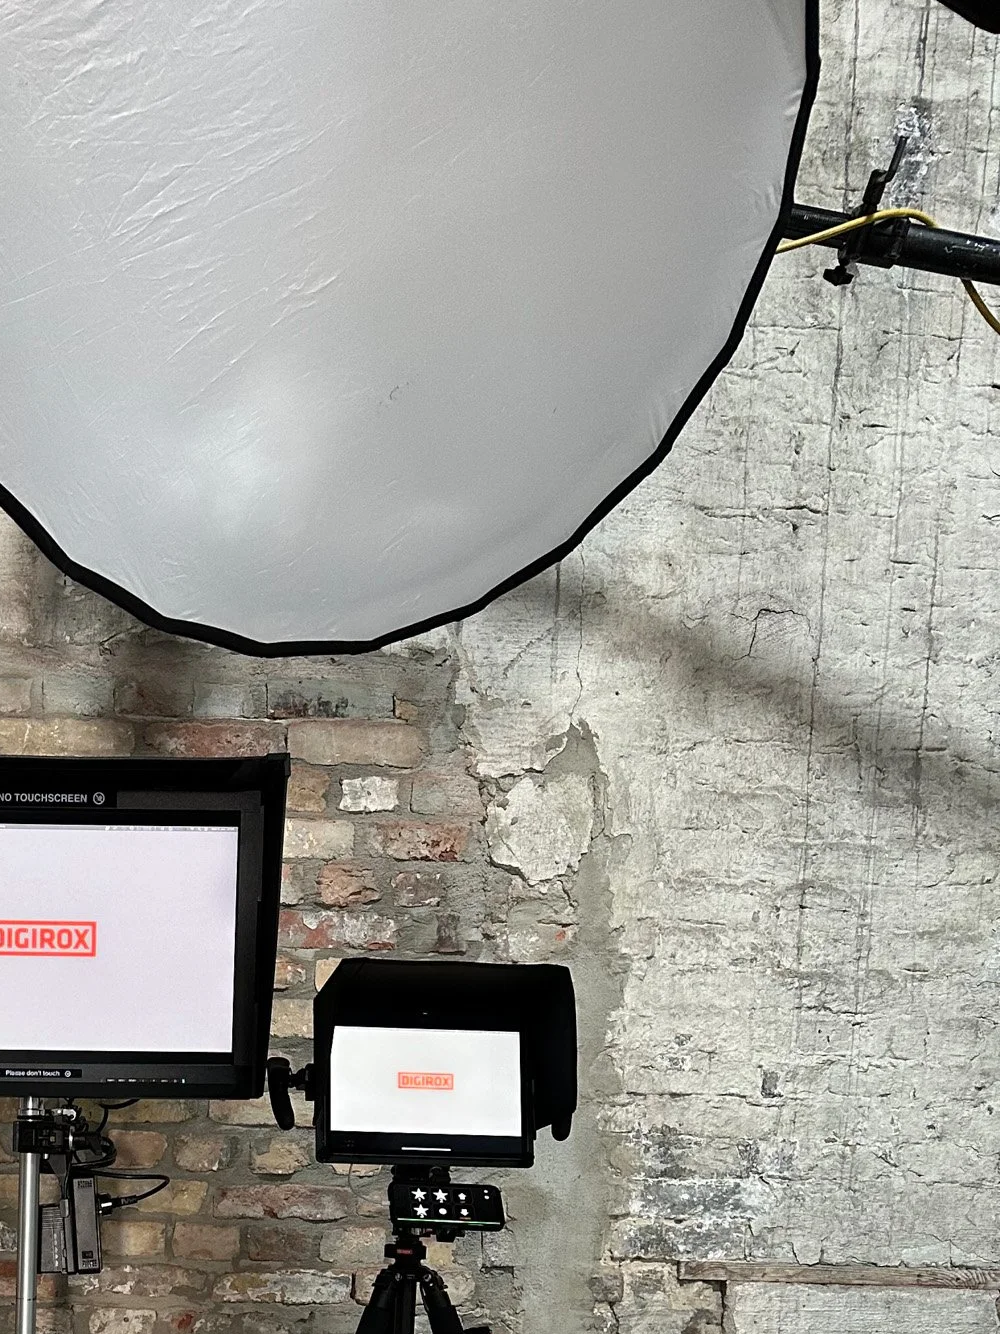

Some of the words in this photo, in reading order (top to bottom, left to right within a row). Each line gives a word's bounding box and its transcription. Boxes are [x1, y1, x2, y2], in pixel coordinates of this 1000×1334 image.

[14, 793, 88, 803] TOUCHSCREEN
[5, 1069, 26, 1077] Please
[26, 1069, 42, 1077] don't
[401, 1075, 450, 1087] DIGIROX
